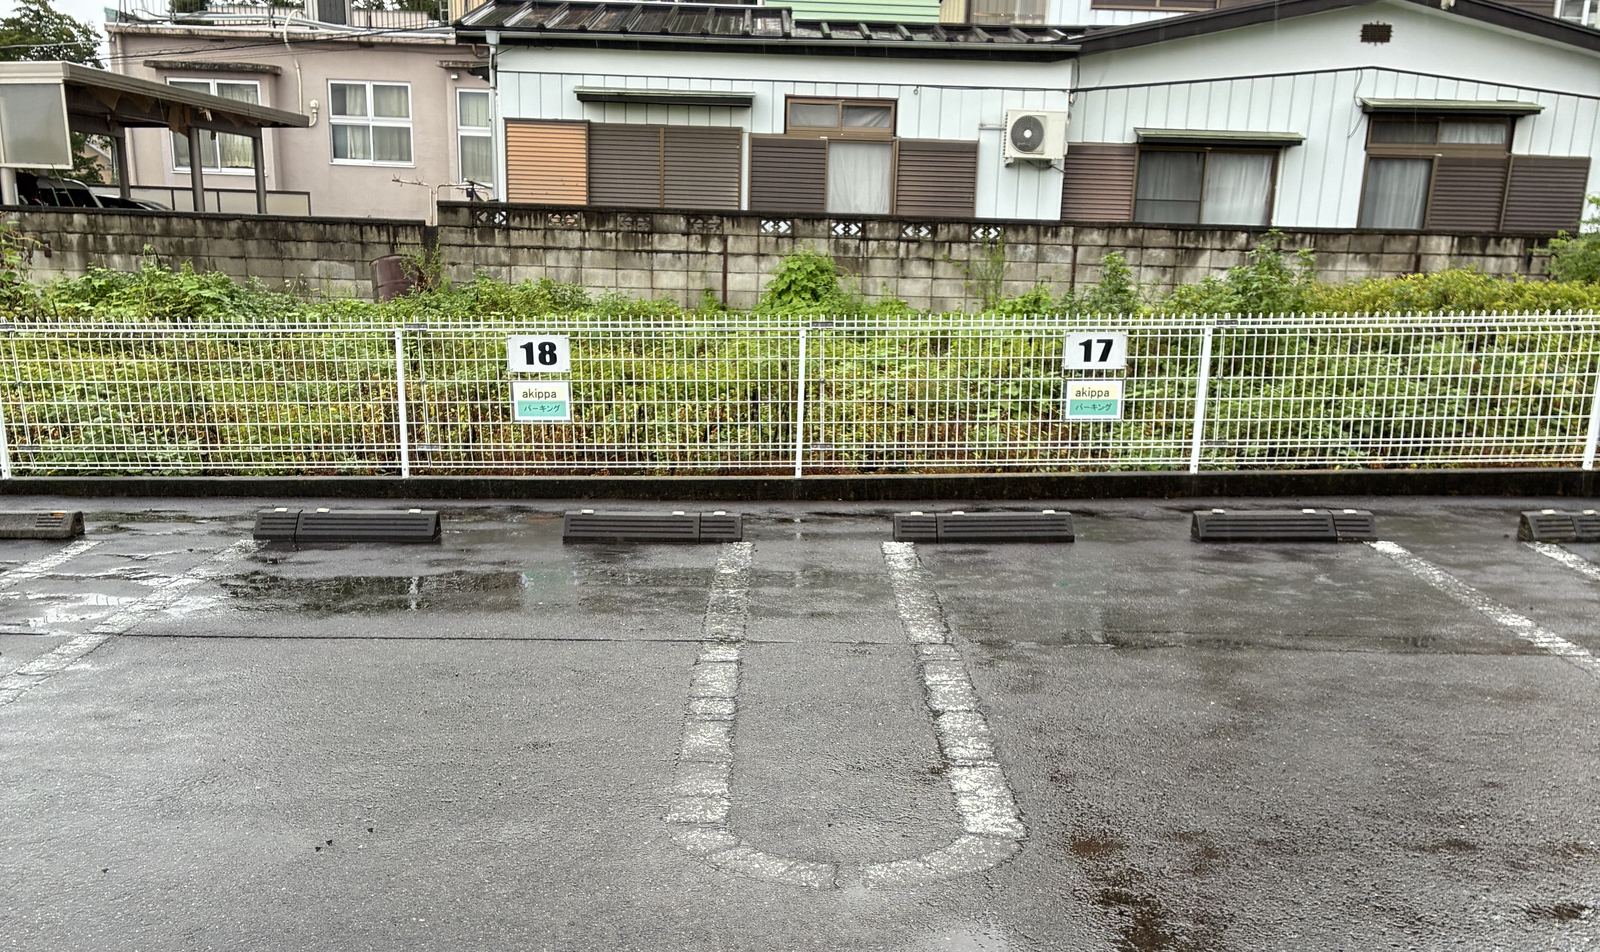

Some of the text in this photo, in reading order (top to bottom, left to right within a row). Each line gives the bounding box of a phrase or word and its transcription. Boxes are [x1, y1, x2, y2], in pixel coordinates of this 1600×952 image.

[520, 341, 557, 366] 18
[1078, 339, 1113, 362] 17
[522, 388, 557, 400] akippa
[1075, 387, 1110, 399] akippa
[523, 404, 561, 413] パーキング
[1075, 403, 1112, 411] パーキング
